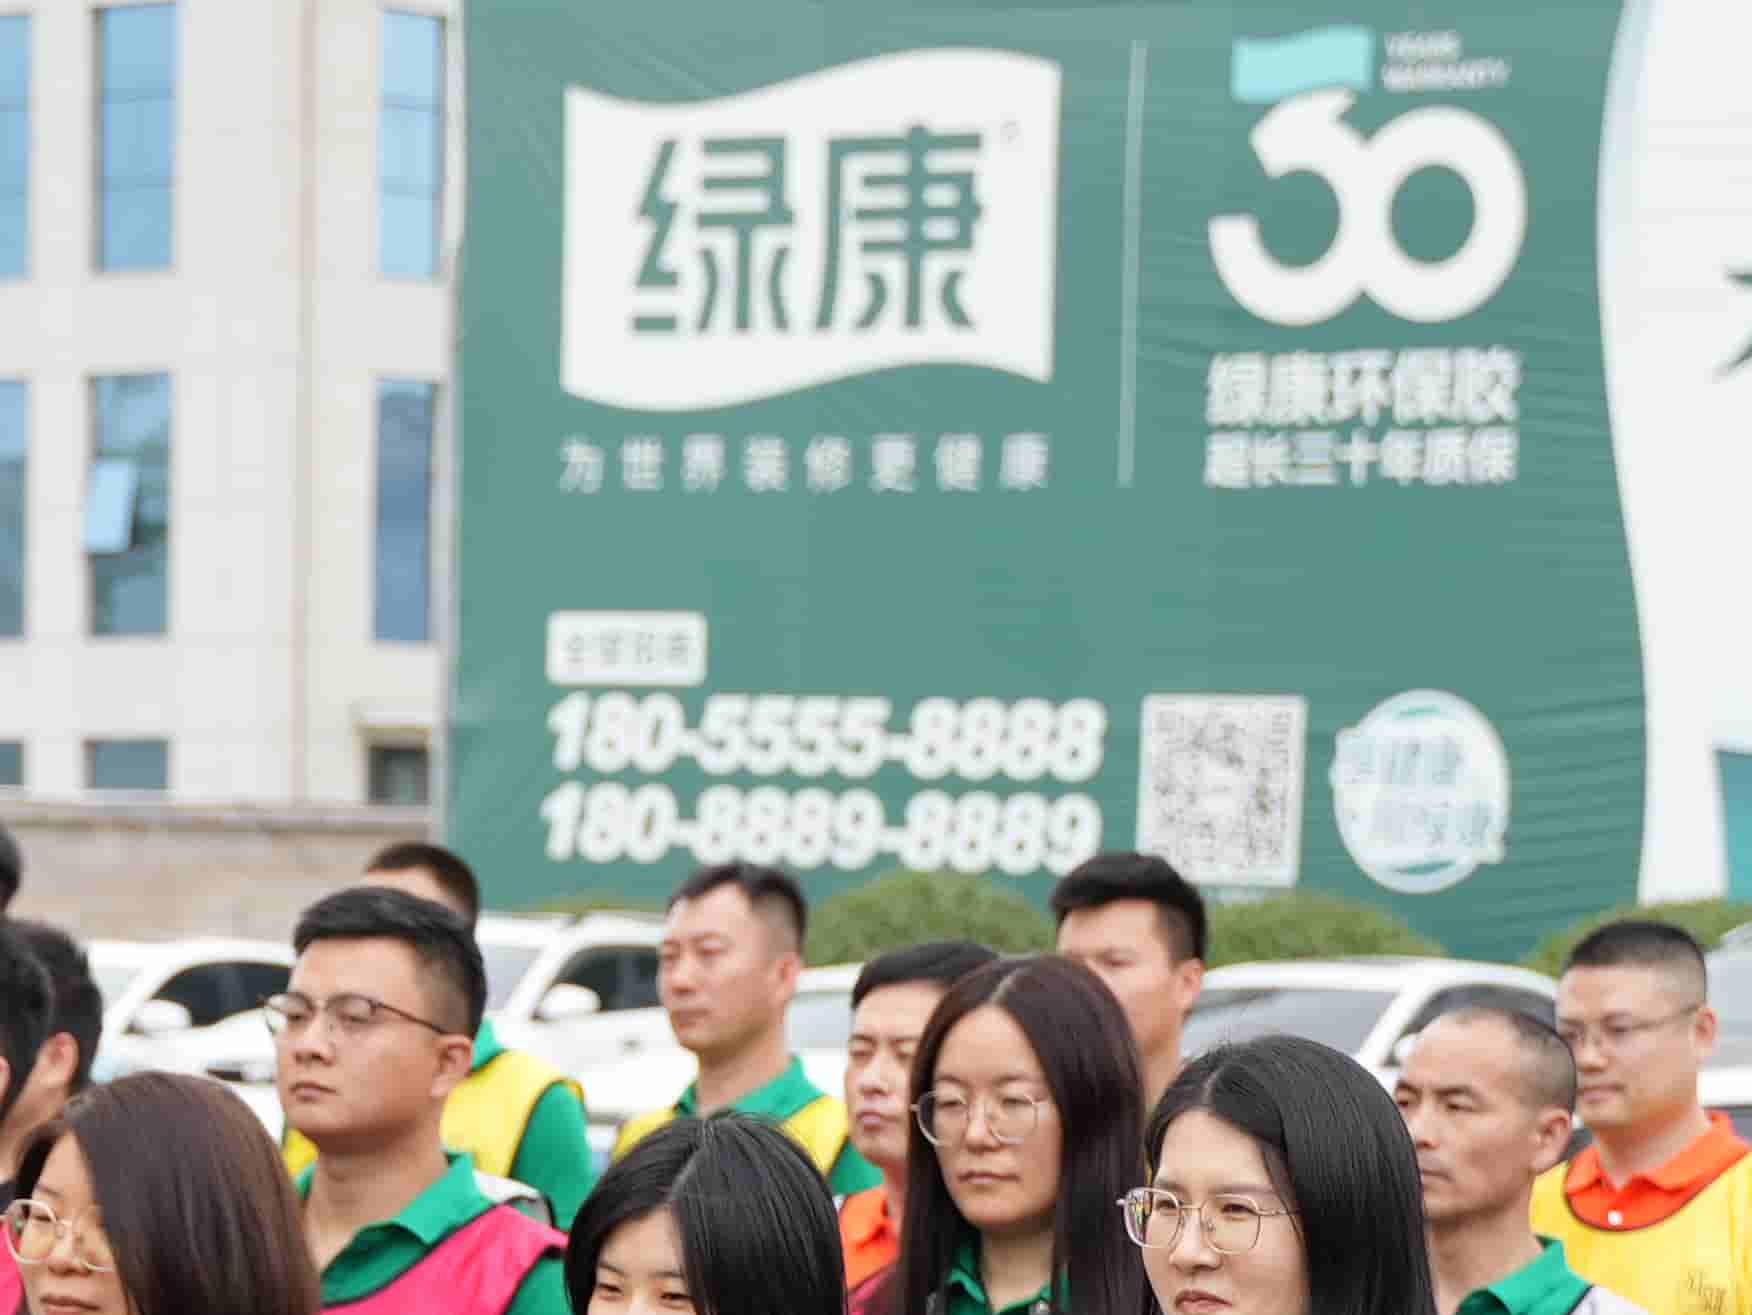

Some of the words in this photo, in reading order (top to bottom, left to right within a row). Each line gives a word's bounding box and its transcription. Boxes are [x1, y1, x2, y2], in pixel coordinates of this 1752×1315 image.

[1208, 25, 1529, 326] 30
[630, 122, 984, 335] 绿康
[1206, 345, 1520, 426] 绿康环保胶
[559, 431, 1050, 494] 为世界装修更健康
[1203, 427, 1520, 489] 超长三十年质保
[545, 690, 1107, 782] 180-5555-8888
[540, 781, 1103, 872] 180-8889-8889
